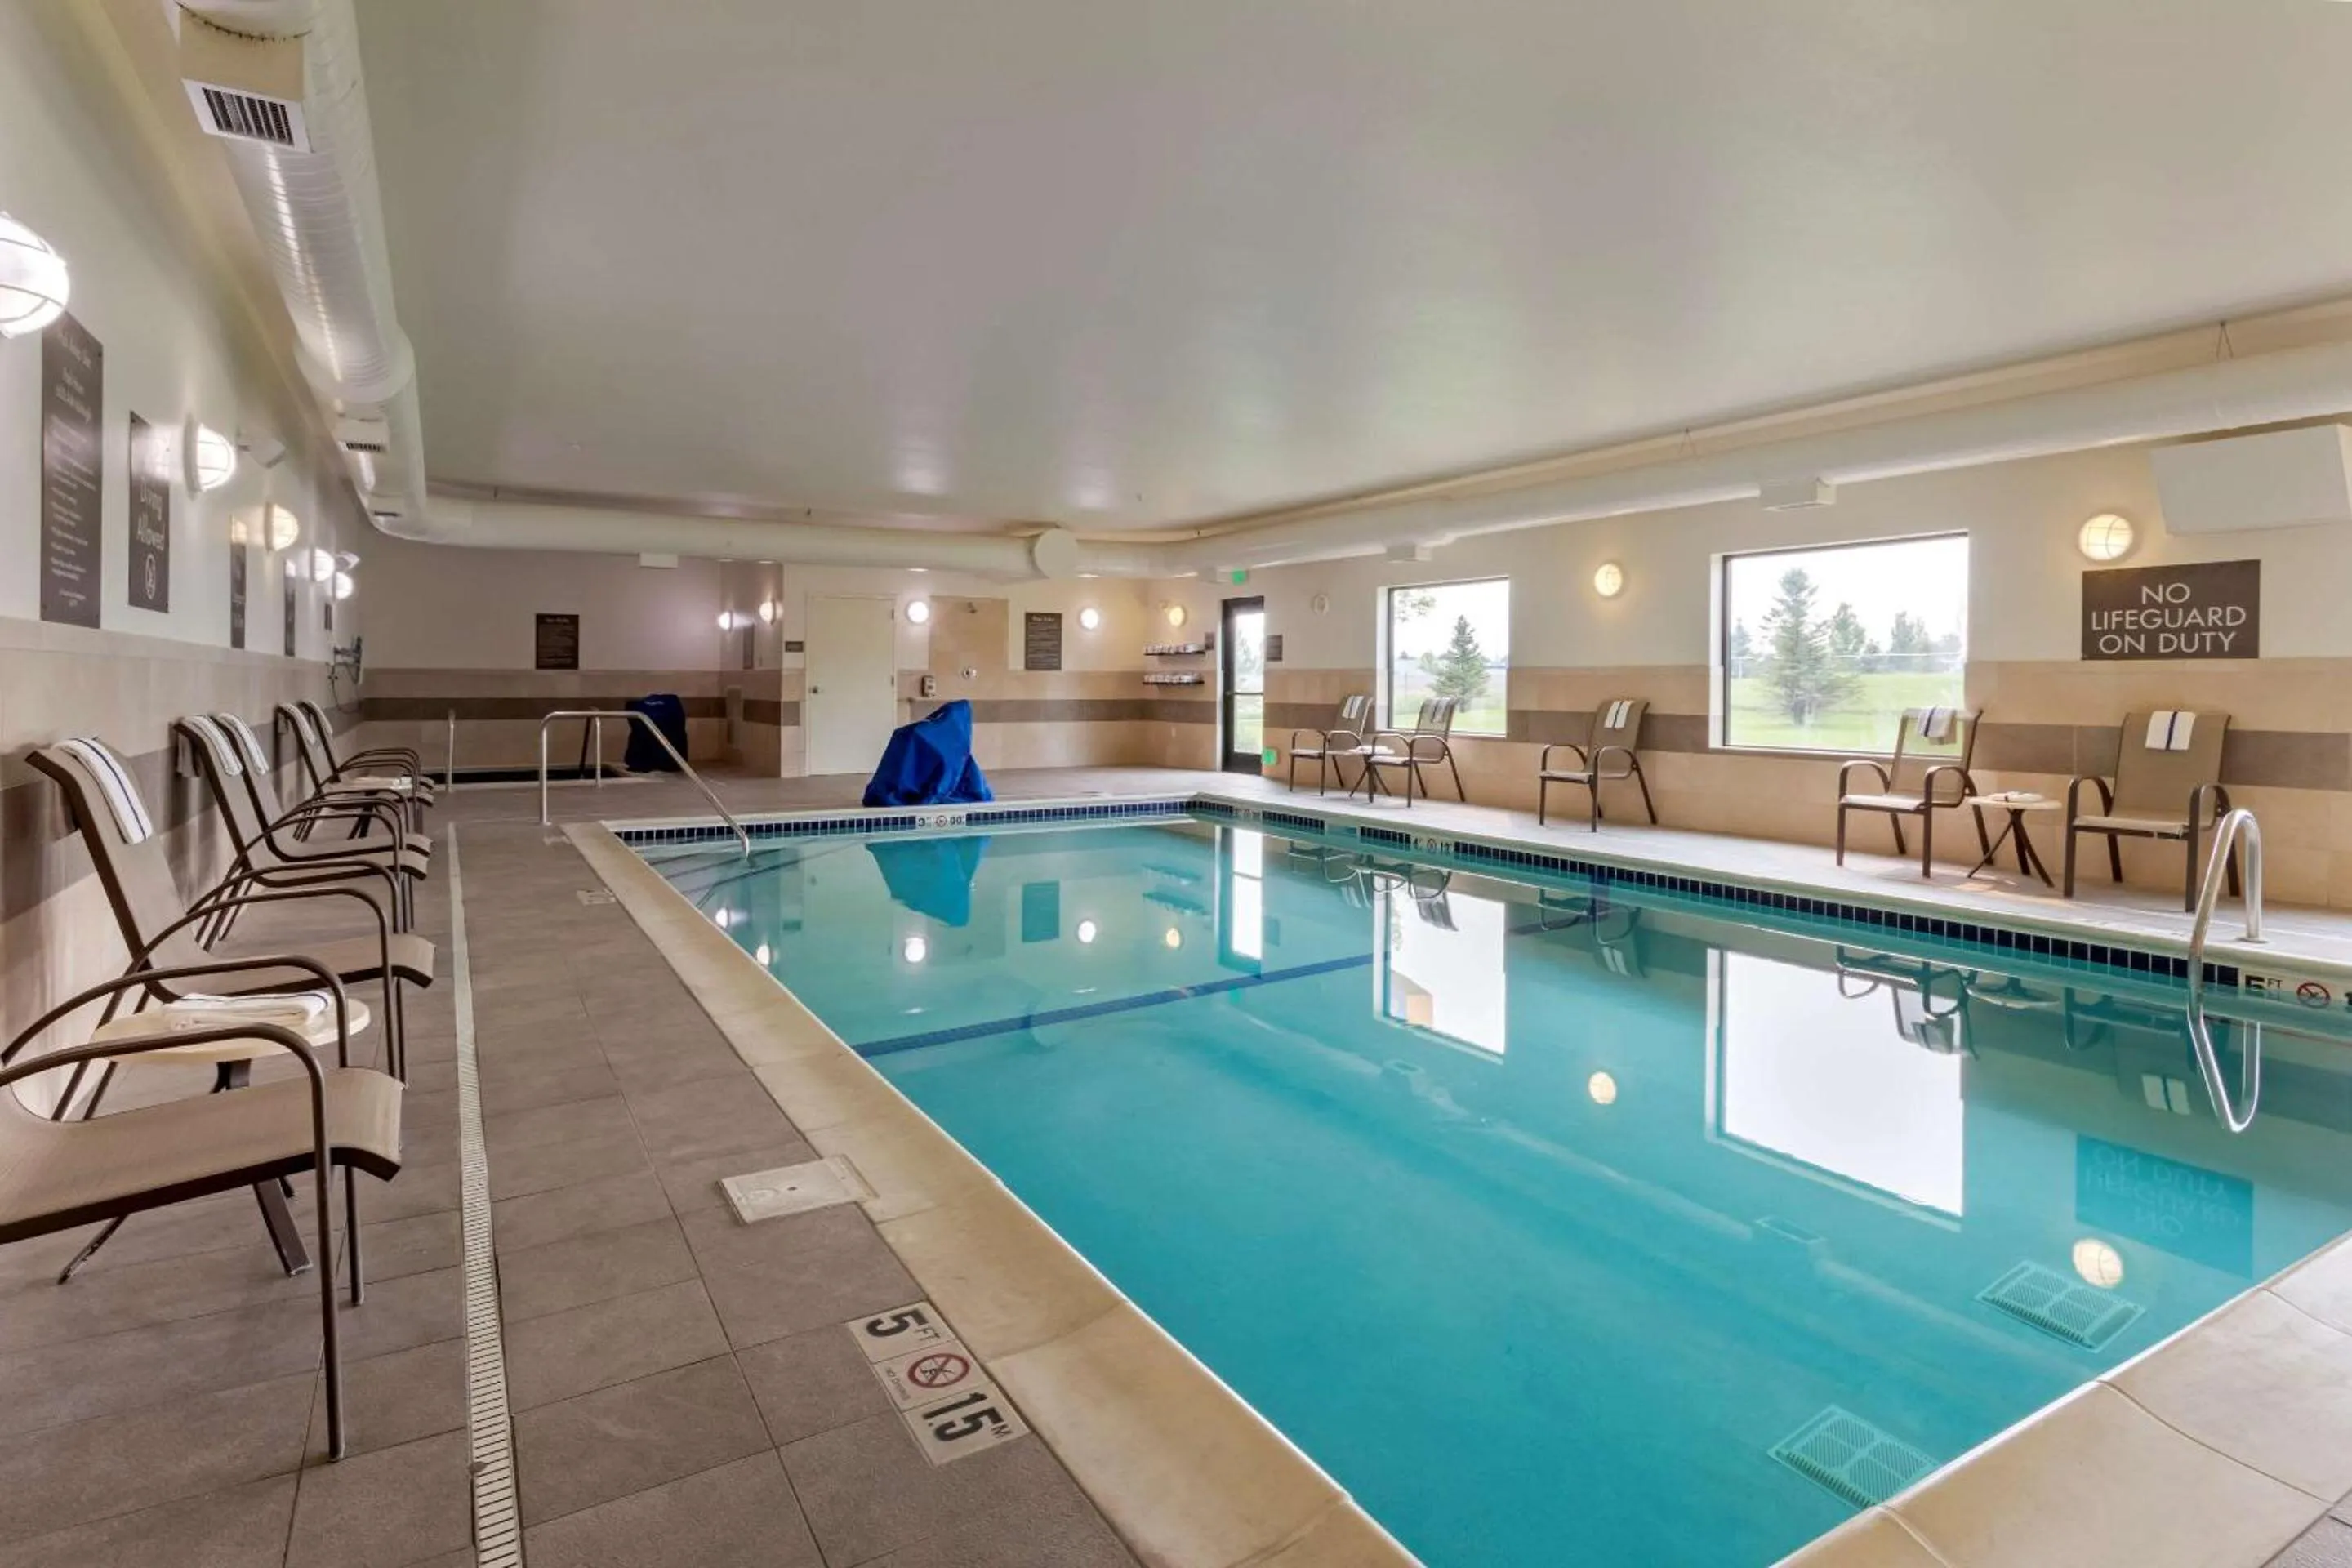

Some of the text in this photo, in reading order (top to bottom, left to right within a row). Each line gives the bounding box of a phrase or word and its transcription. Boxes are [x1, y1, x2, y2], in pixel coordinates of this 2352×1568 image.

[2141, 583, 2191, 605] NO
[2091, 606, 2247, 630] LIFEGUARD
[2099, 631, 2237, 654] ON DUTY
[866, 1308, 941, 1341] 5 FT
[922, 1392, 1004, 1441] 1.5
